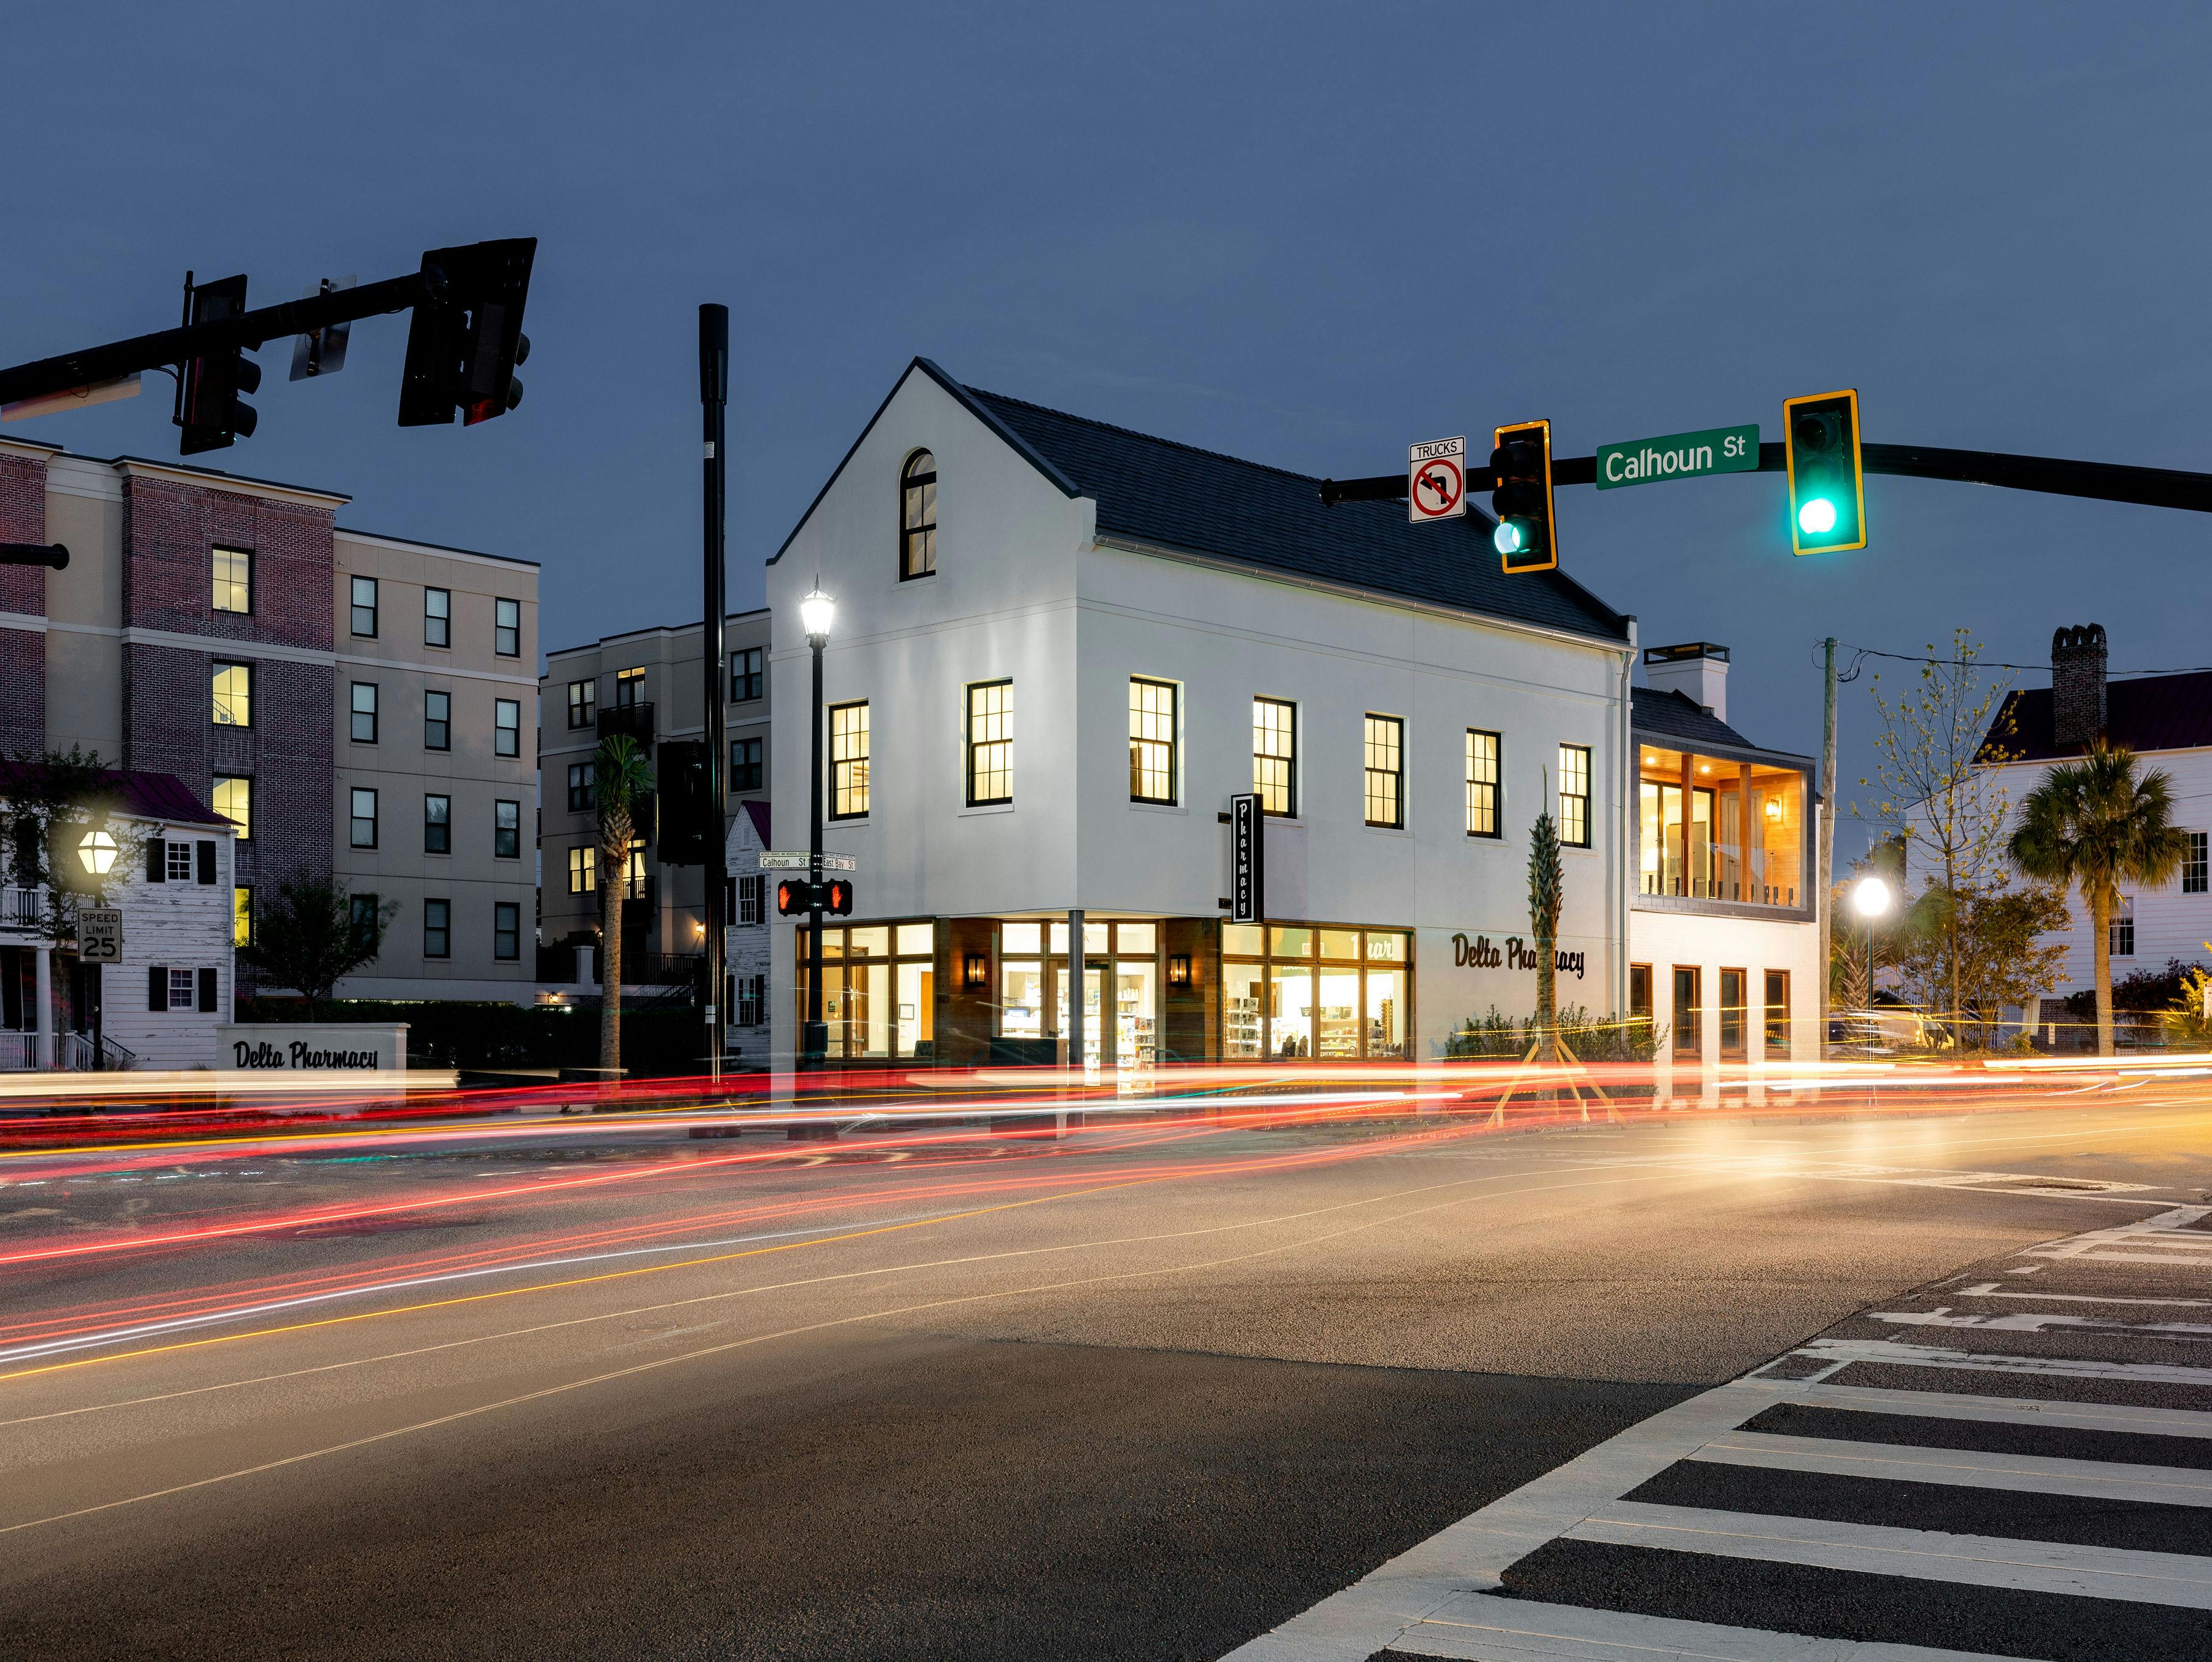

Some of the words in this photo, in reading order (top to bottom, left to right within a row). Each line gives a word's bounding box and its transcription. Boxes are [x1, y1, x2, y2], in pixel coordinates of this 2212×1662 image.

[1417, 441, 1457, 458] TRUCKS
[1606, 445, 1712, 482] Calhoun
[1723, 435, 1746, 457] St
[799, 858, 806, 866] St
[823, 858, 834, 867] East
[835, 859, 844, 869] Bay
[848, 861, 853, 869] St
[1239, 802, 1248, 915] Pharmacy
[82, 913, 118, 922] SPEED
[86, 926, 114, 935] LIMIT
[84, 936, 116, 957] 25
[1451, 932, 1502, 969] Delta
[1505, 936, 1585, 980] Phaacy
[233, 1041, 285, 1068] Delta
[289, 1041, 378, 1072] Pharmacy
